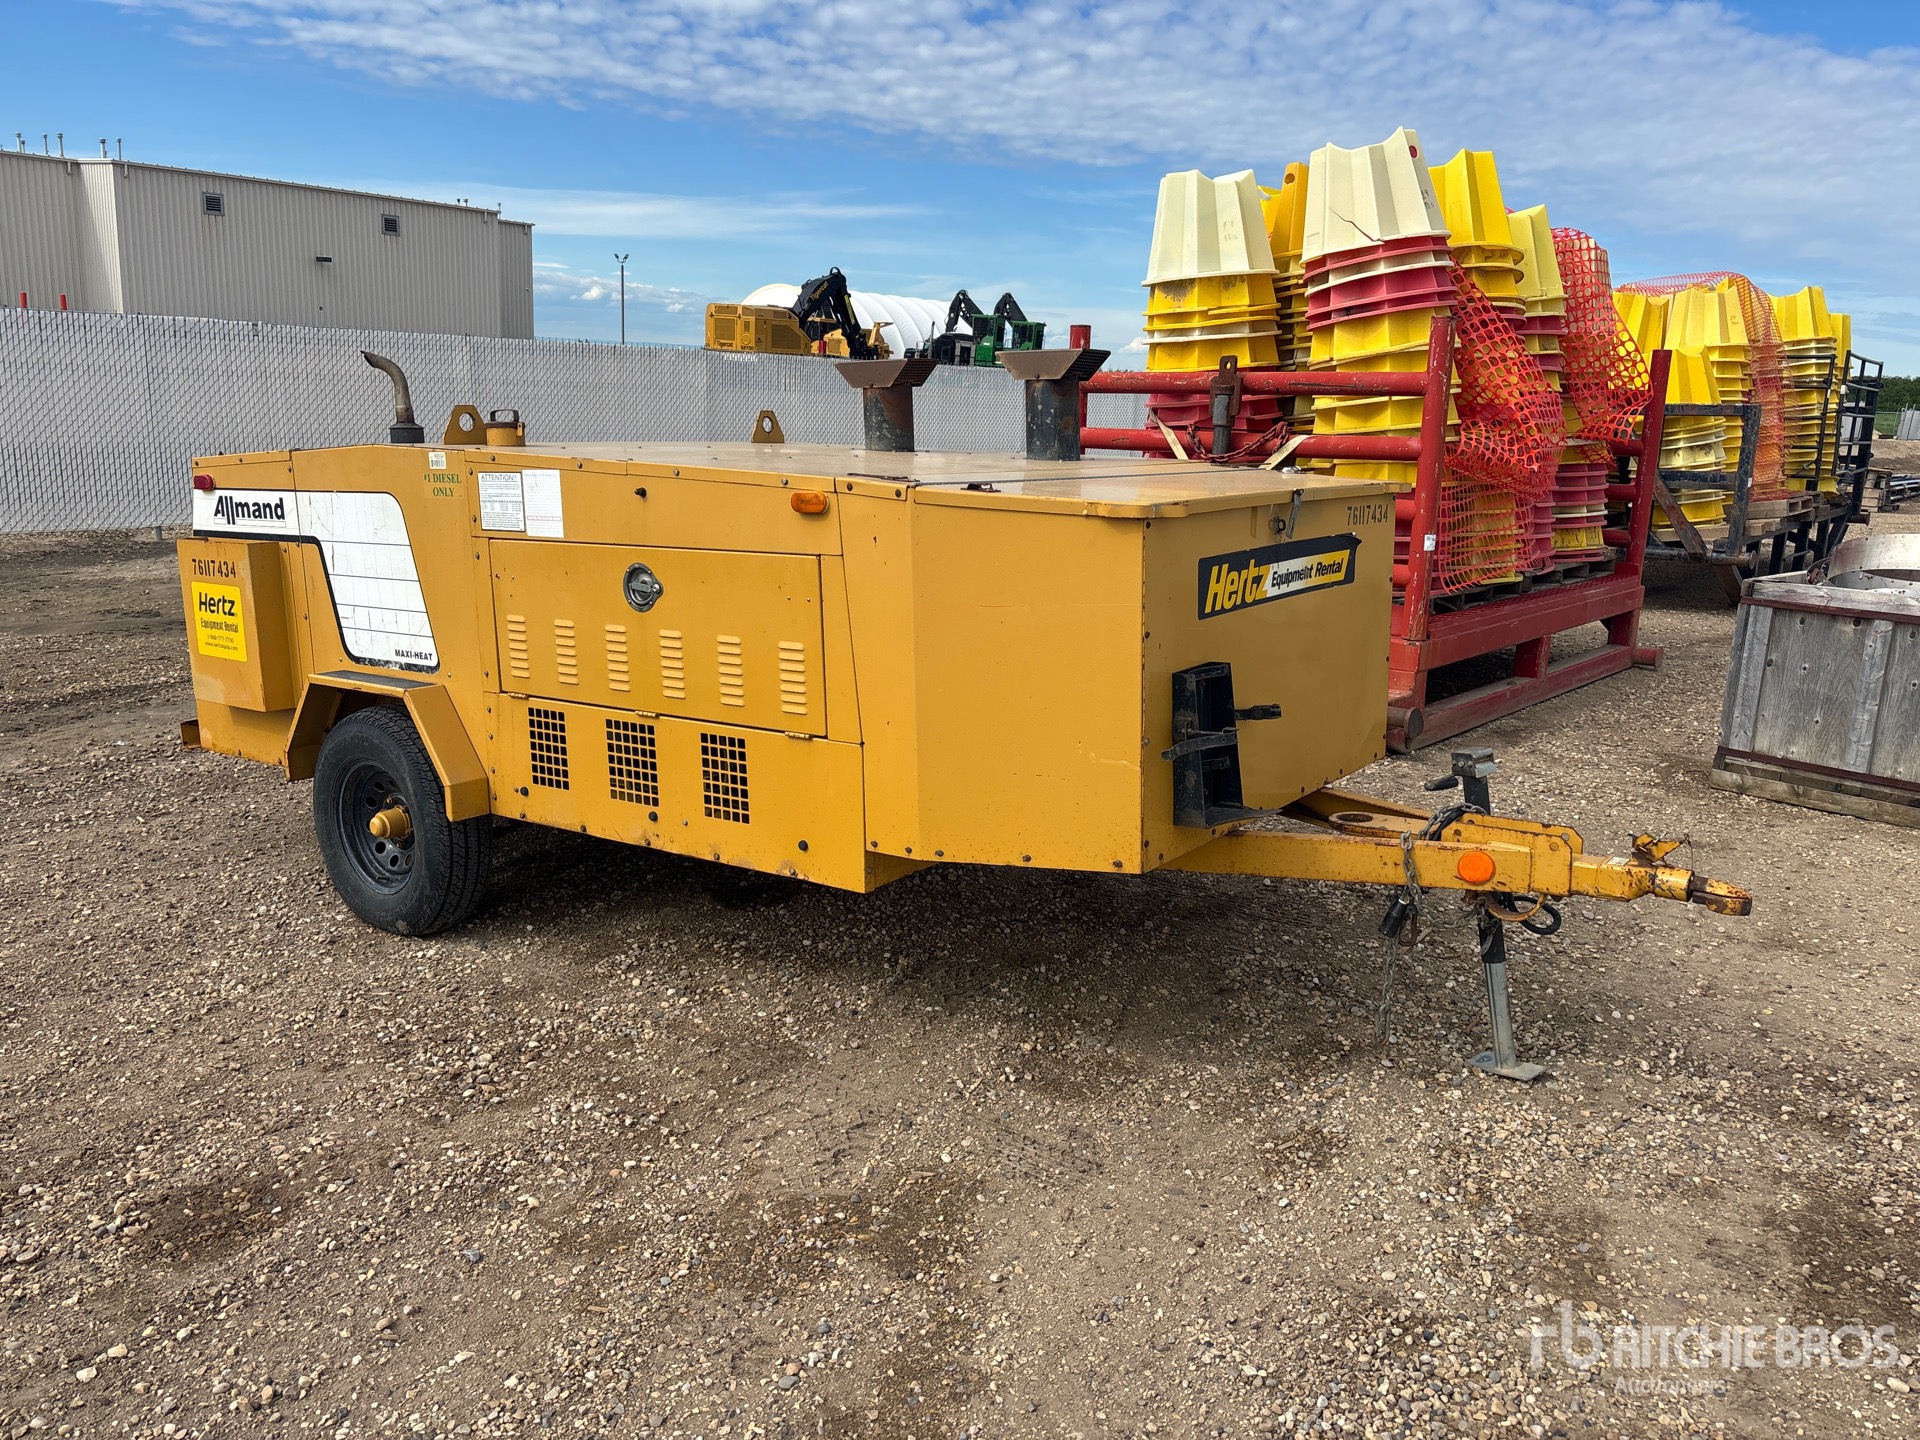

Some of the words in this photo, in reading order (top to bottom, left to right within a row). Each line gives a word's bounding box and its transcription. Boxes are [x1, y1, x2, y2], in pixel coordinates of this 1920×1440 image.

[716, 340, 734, 349] Tigercat
[423, 473, 431, 483] #1
[432, 473, 462, 484] DIESEL
[432, 486, 455, 497] ONLY
[213, 495, 286, 525] Allmand
[1347, 503, 1389, 526] 76117434
[191, 558, 237, 579] 76117434
[1204, 558, 1271, 614] Hertz
[1271, 566, 1314, 590] Equipment
[1314, 557, 1345, 578] Rental
[198, 591, 236, 617] Hertz
[200, 617, 224, 631] Equipment
[224, 620, 239, 633] Rental
[394, 648, 433, 662] MAXI-HEAT
